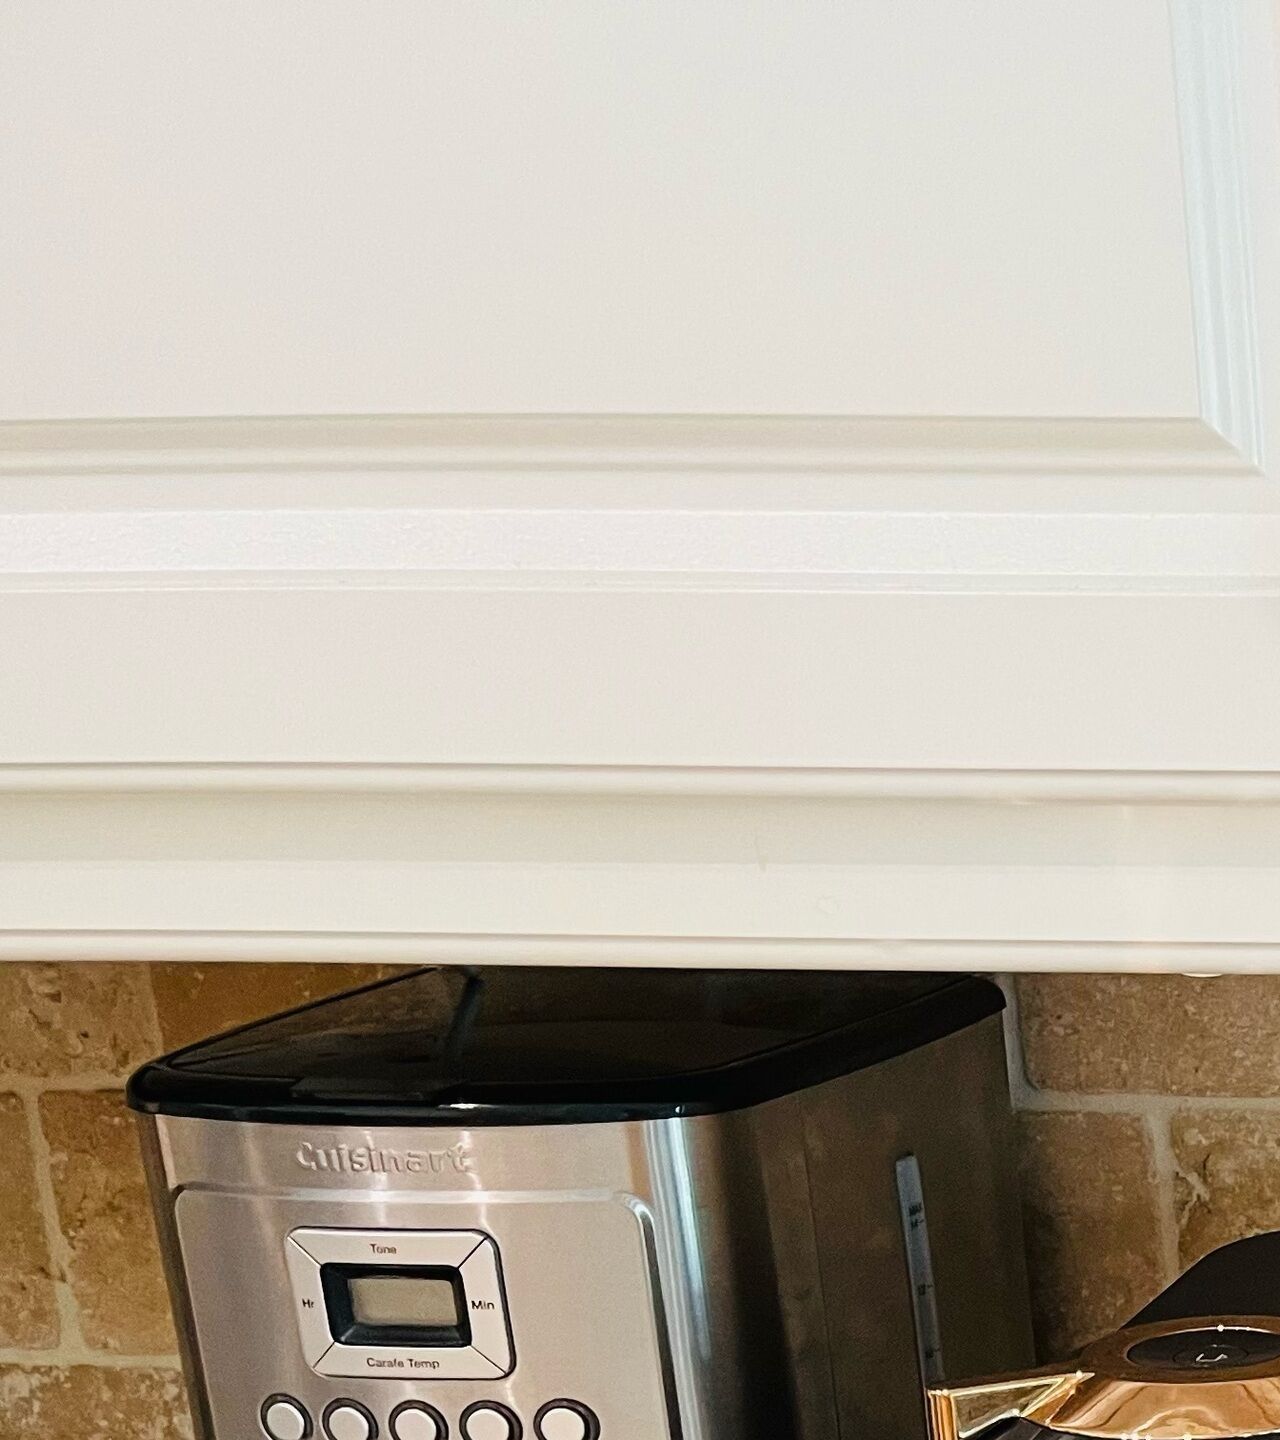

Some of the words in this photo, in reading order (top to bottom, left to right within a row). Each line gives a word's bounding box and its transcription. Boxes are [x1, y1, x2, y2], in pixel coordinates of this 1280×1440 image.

[296, 1141, 473, 1175] Cuisinart
[302, 1299, 314, 1309] Hr
[472, 1300, 495, 1311] Min
[408, 1358, 440, 1370] Temp
